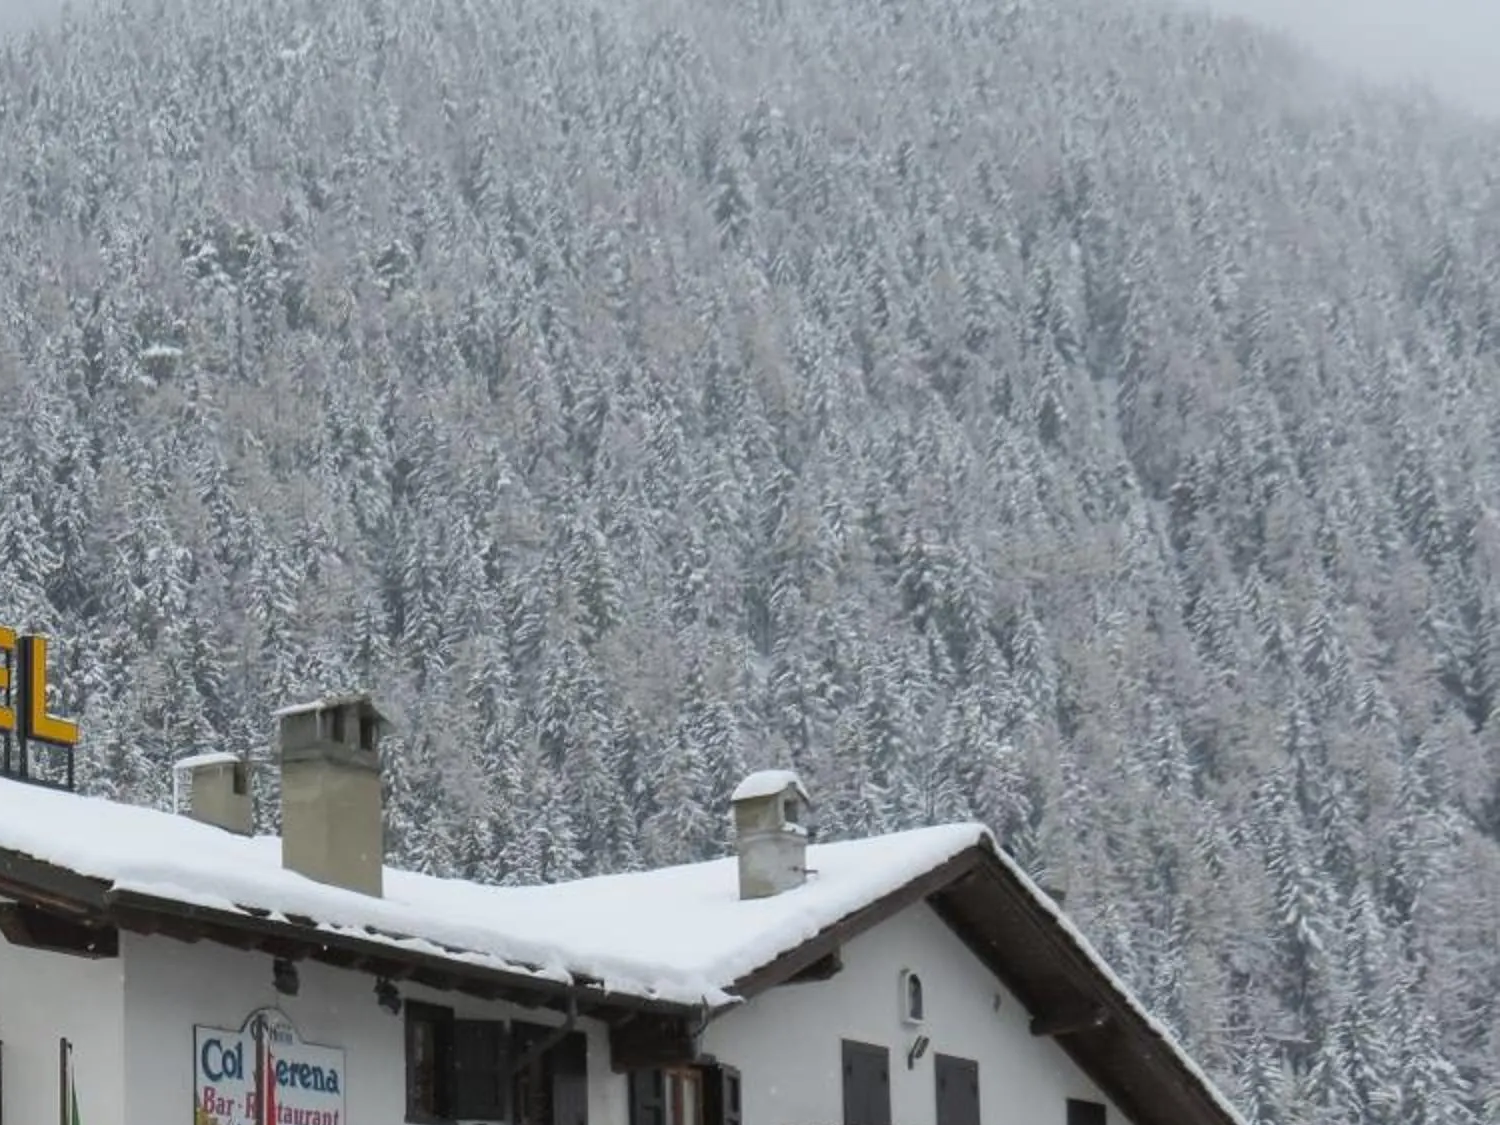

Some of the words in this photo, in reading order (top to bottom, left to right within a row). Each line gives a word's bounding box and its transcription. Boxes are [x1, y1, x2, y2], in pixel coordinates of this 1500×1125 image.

[201, 1038, 244, 1082] Col
[253, 1048, 340, 1095] erena
[202, 1085, 235, 1117] Bar
